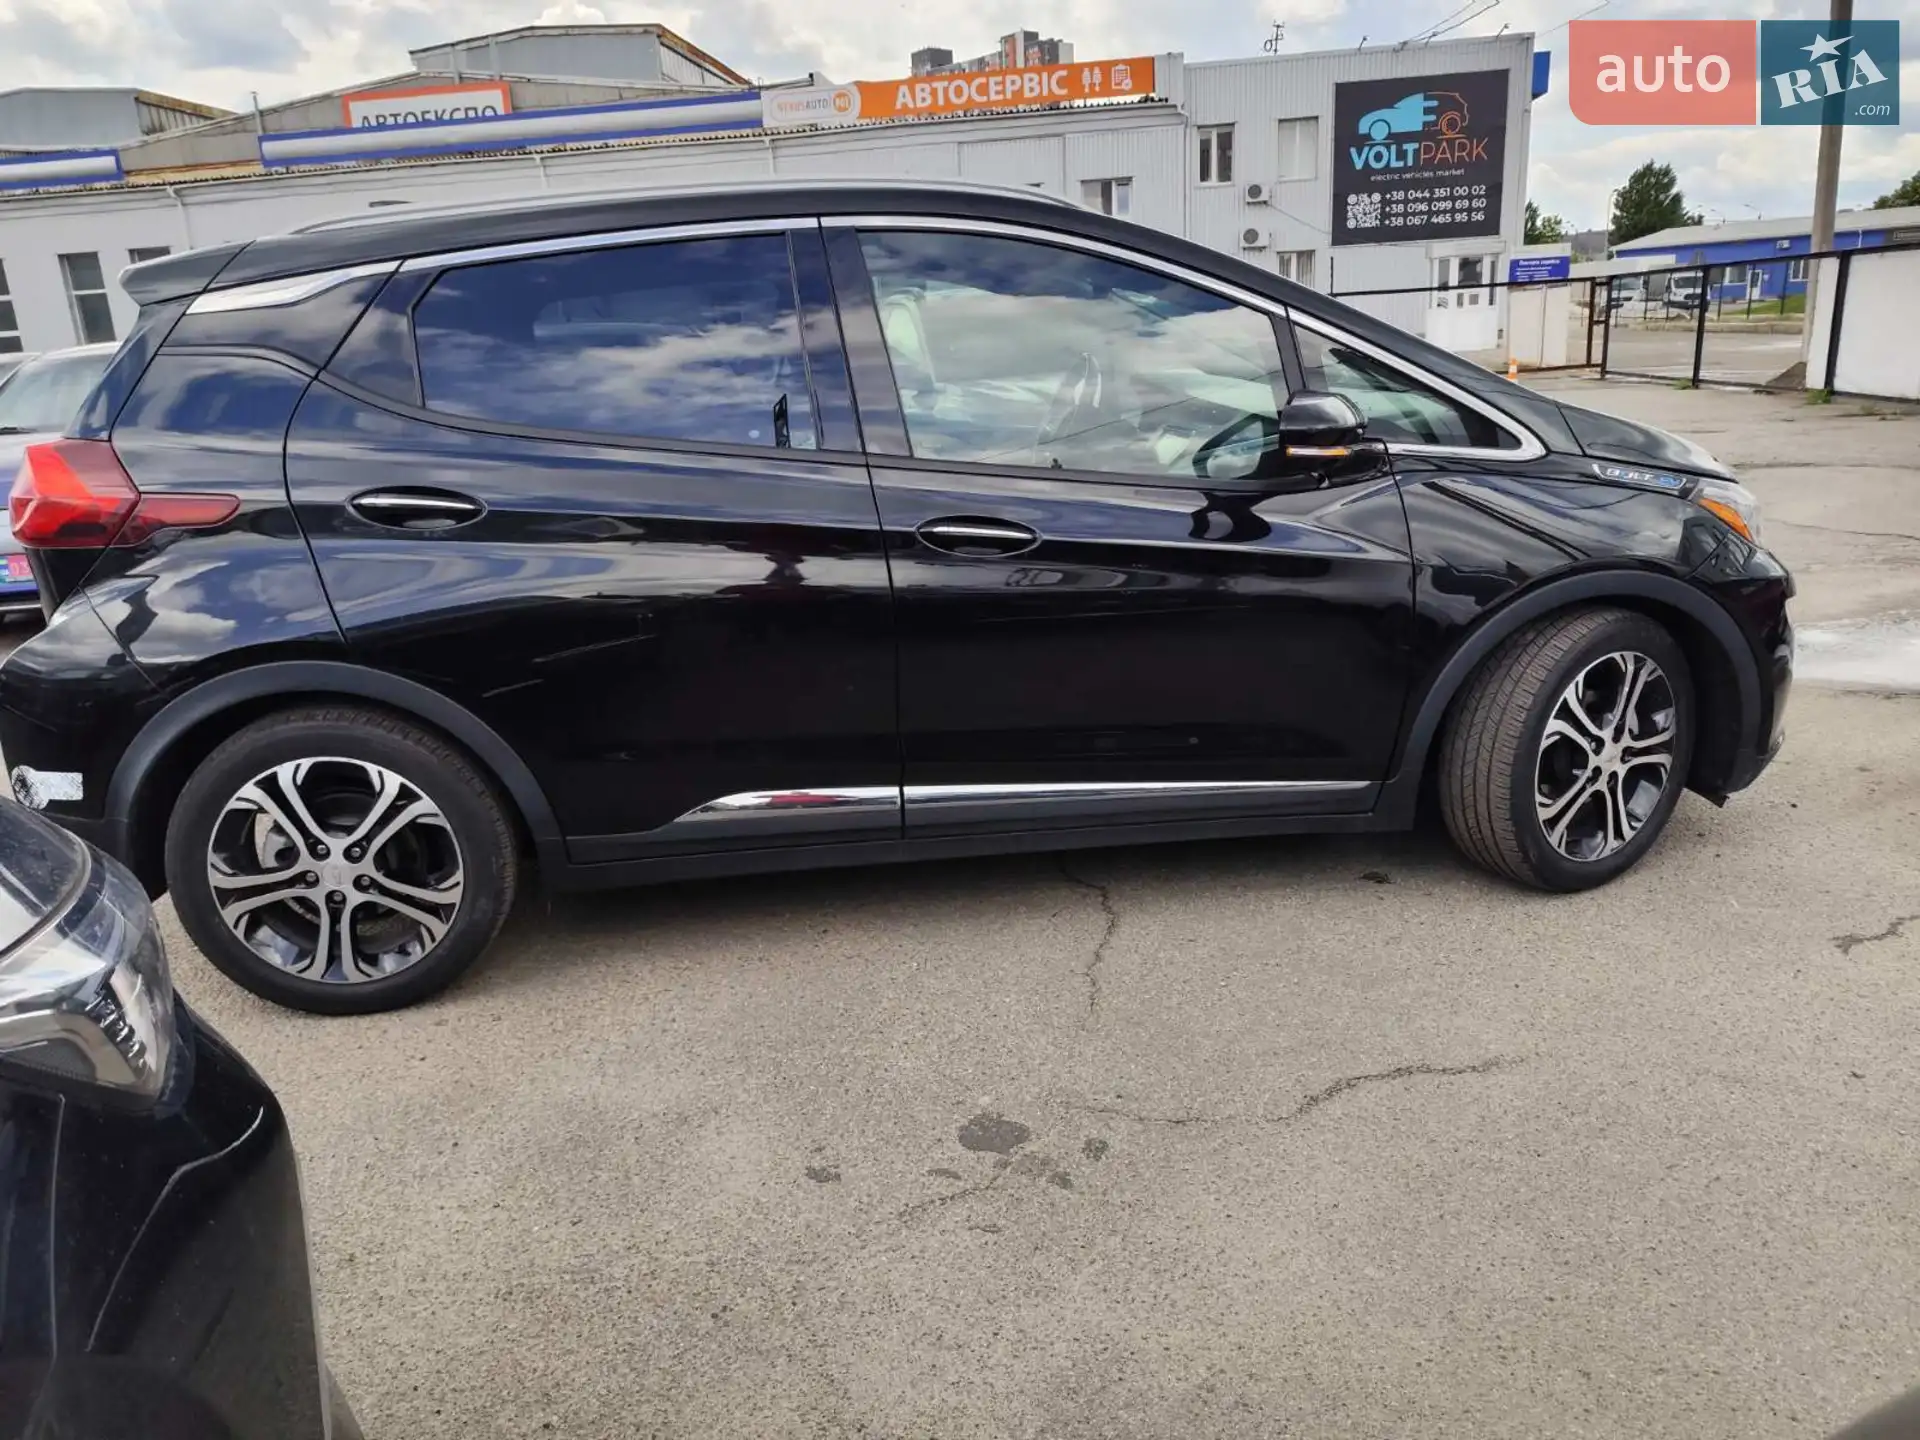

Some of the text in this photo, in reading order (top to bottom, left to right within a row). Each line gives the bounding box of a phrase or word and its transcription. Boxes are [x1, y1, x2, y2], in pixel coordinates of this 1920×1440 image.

[895, 70, 1068, 110] АВТОСЕРВІС
[1370, 167, 1465, 182] electric vehicles market
[1385, 184, 1486, 201] +38 044 351 00 02
[1385, 198, 1487, 214] +38 096 099 69 60
[1384, 211, 1485, 227] +38 067 465 95 56
